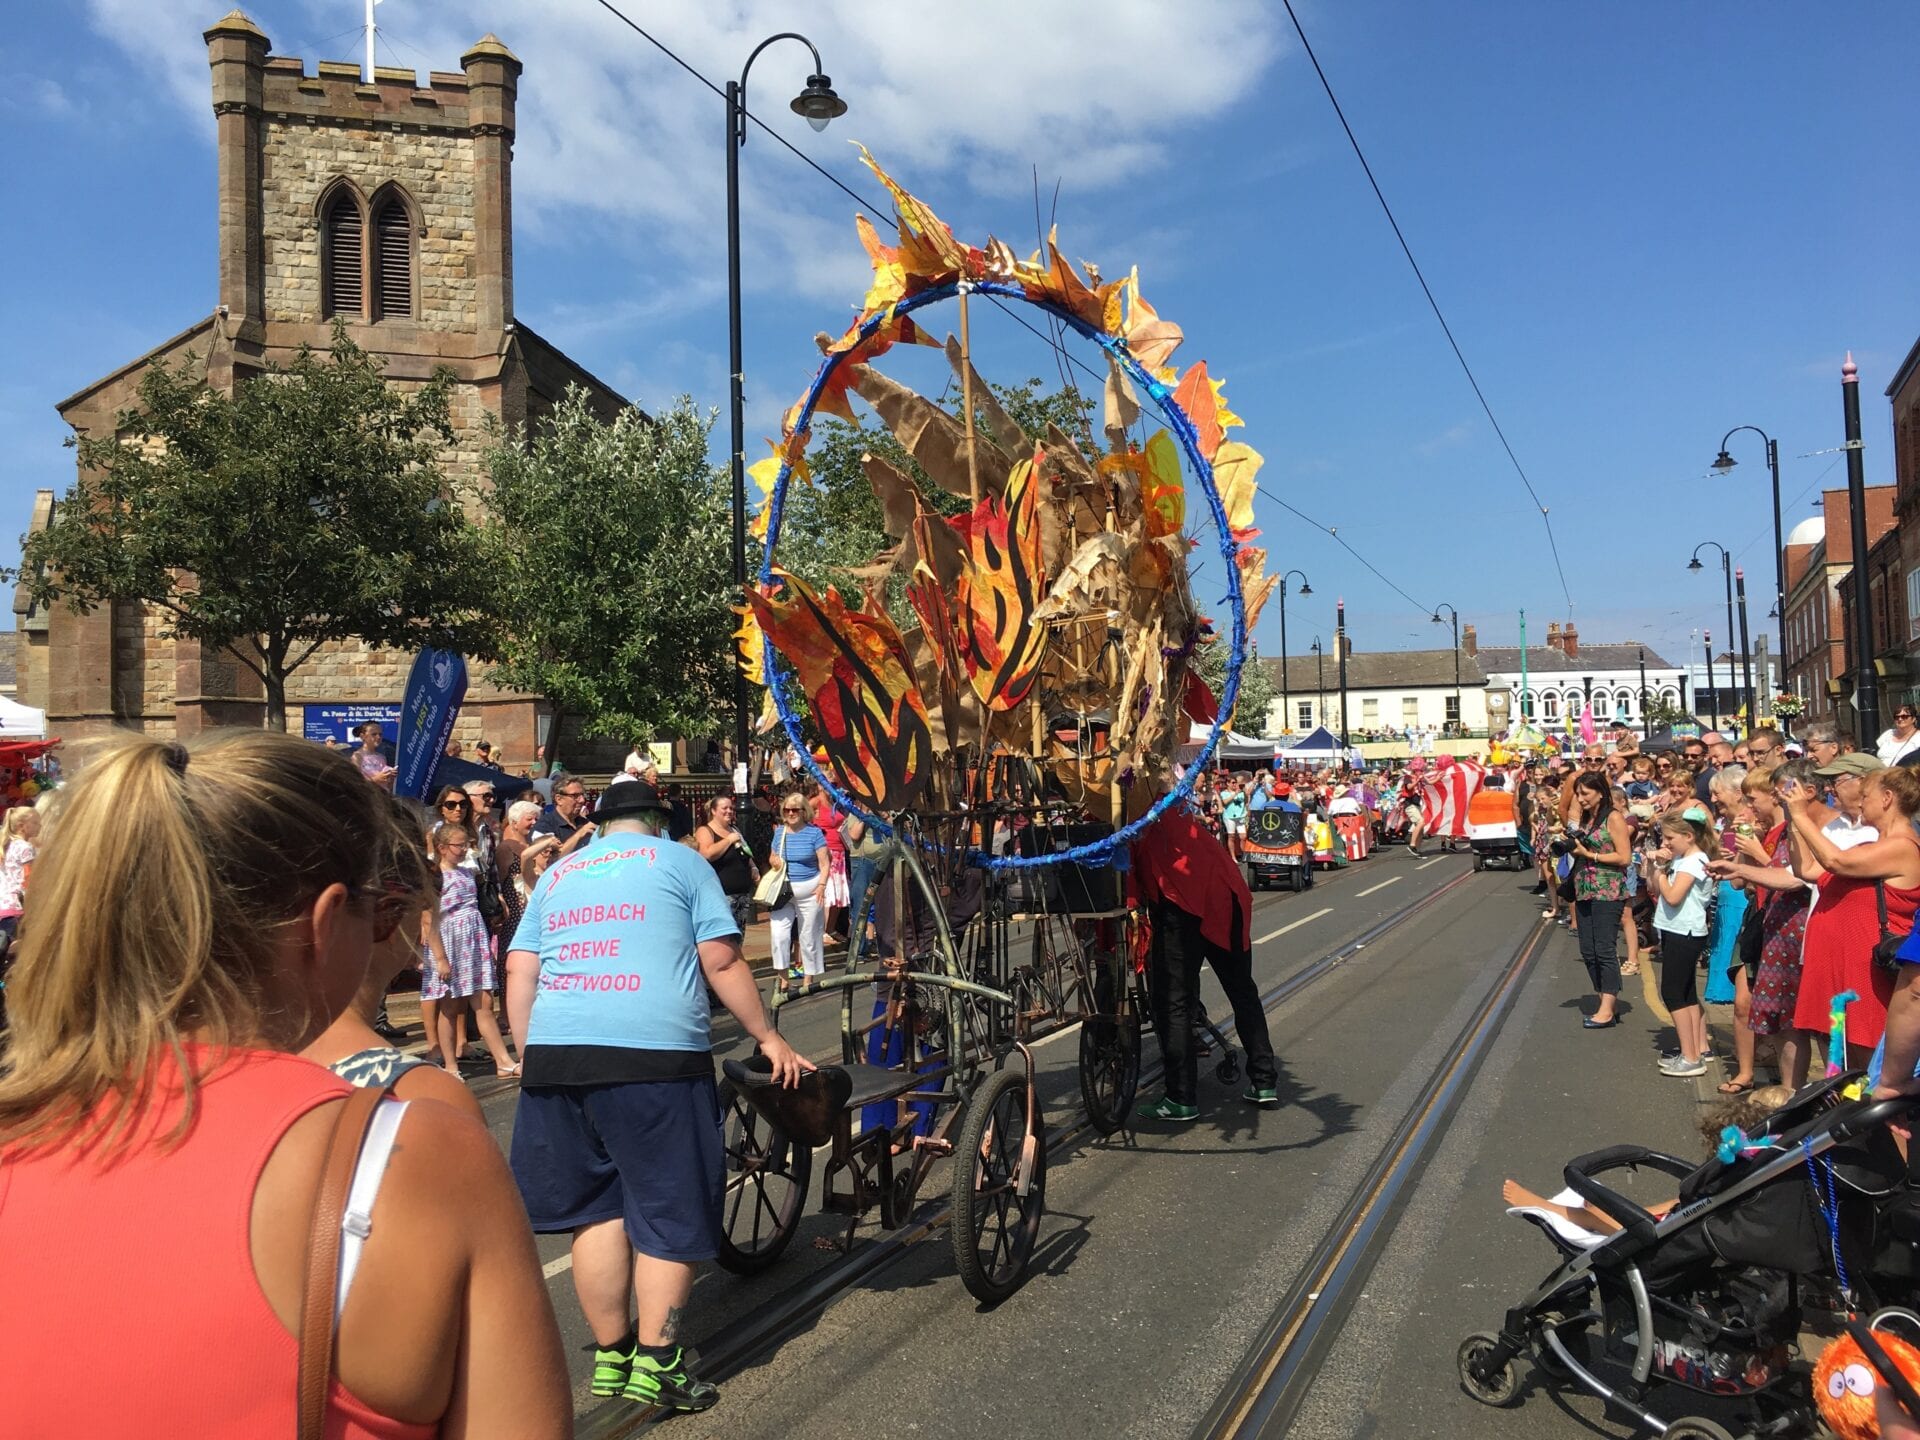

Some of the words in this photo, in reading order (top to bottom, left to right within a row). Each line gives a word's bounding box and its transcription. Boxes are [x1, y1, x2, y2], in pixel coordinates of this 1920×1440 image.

[411, 684, 426, 714] More
[406, 729, 420, 755] than
[415, 703, 430, 733] JUST
[405, 729, 431, 788] Swimming
[426, 704, 438, 729] Club
[548, 903, 646, 932] SANDBACH
[558, 939, 621, 962] CREWE
[1682, 1201, 1706, 1218] Miami
